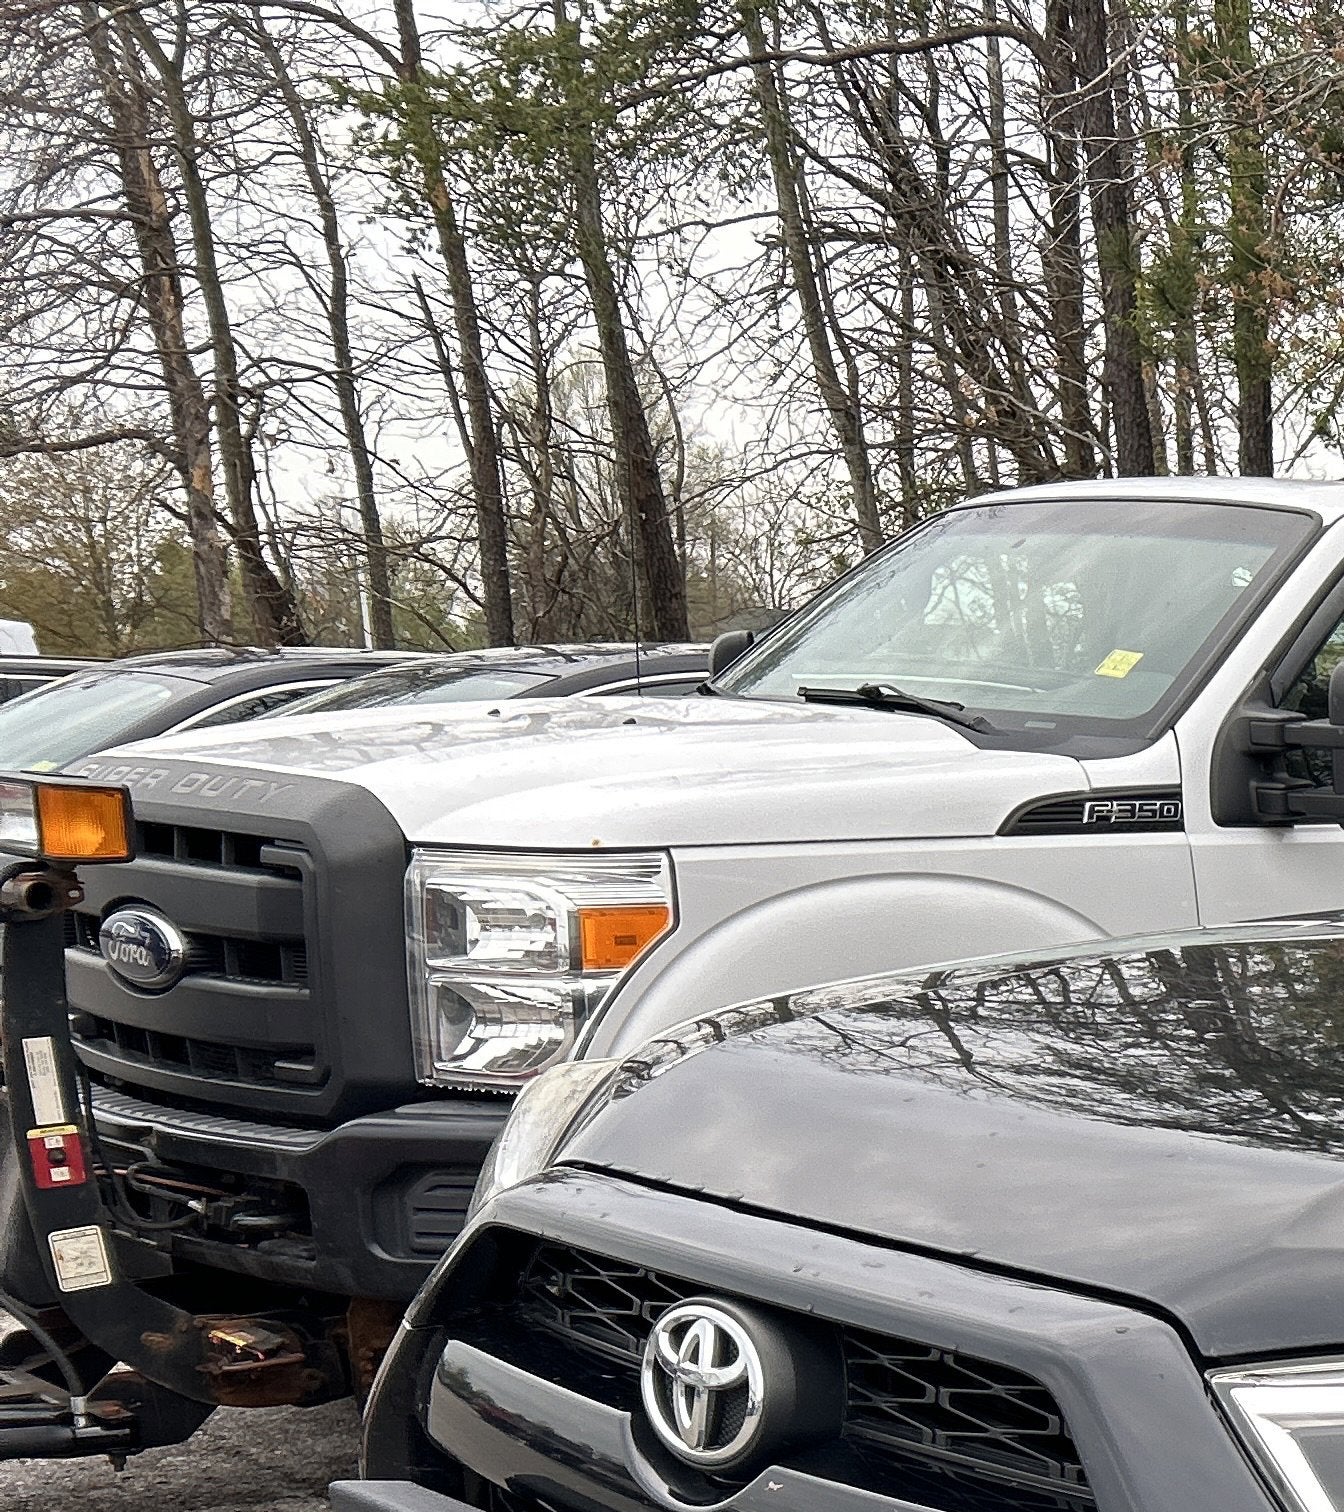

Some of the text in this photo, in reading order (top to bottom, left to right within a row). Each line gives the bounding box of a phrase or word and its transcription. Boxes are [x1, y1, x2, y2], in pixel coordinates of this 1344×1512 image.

[78, 763, 295, 801] SUPER DUTY
[107, 921, 150, 967] Ford
